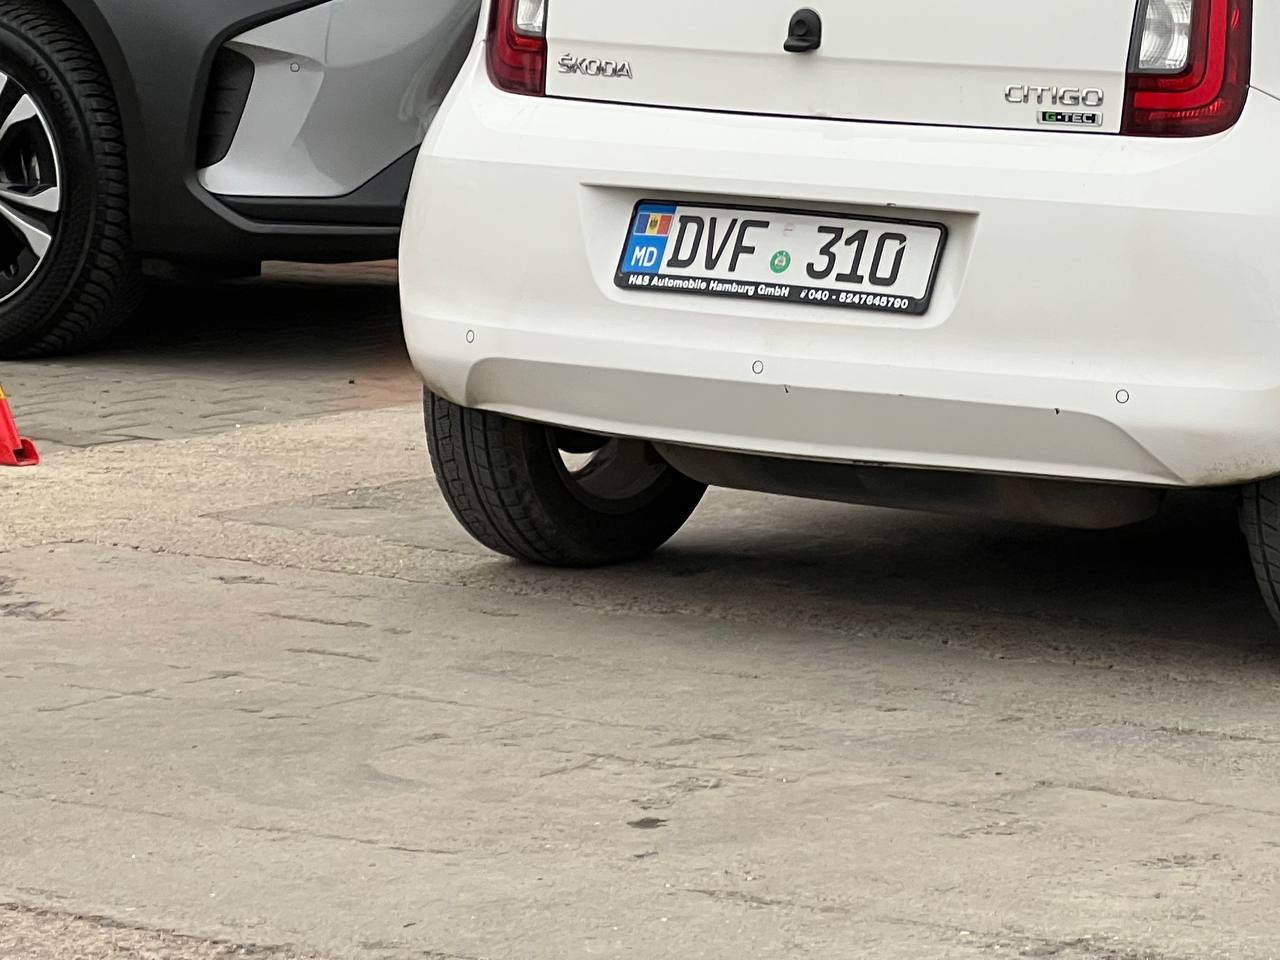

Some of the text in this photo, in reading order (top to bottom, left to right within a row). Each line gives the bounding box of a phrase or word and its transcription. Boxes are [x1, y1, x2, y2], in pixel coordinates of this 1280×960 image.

[1004, 84, 1105, 108] CITIGO
[631, 215, 907, 287] MD DVF 310
[628, 274, 651, 286] H&S
[651, 277, 707, 291] Automobile
[709, 281, 755, 296] Hamburg
[757, 284, 790, 298] GmbH
[808, 289, 830, 301] 040
